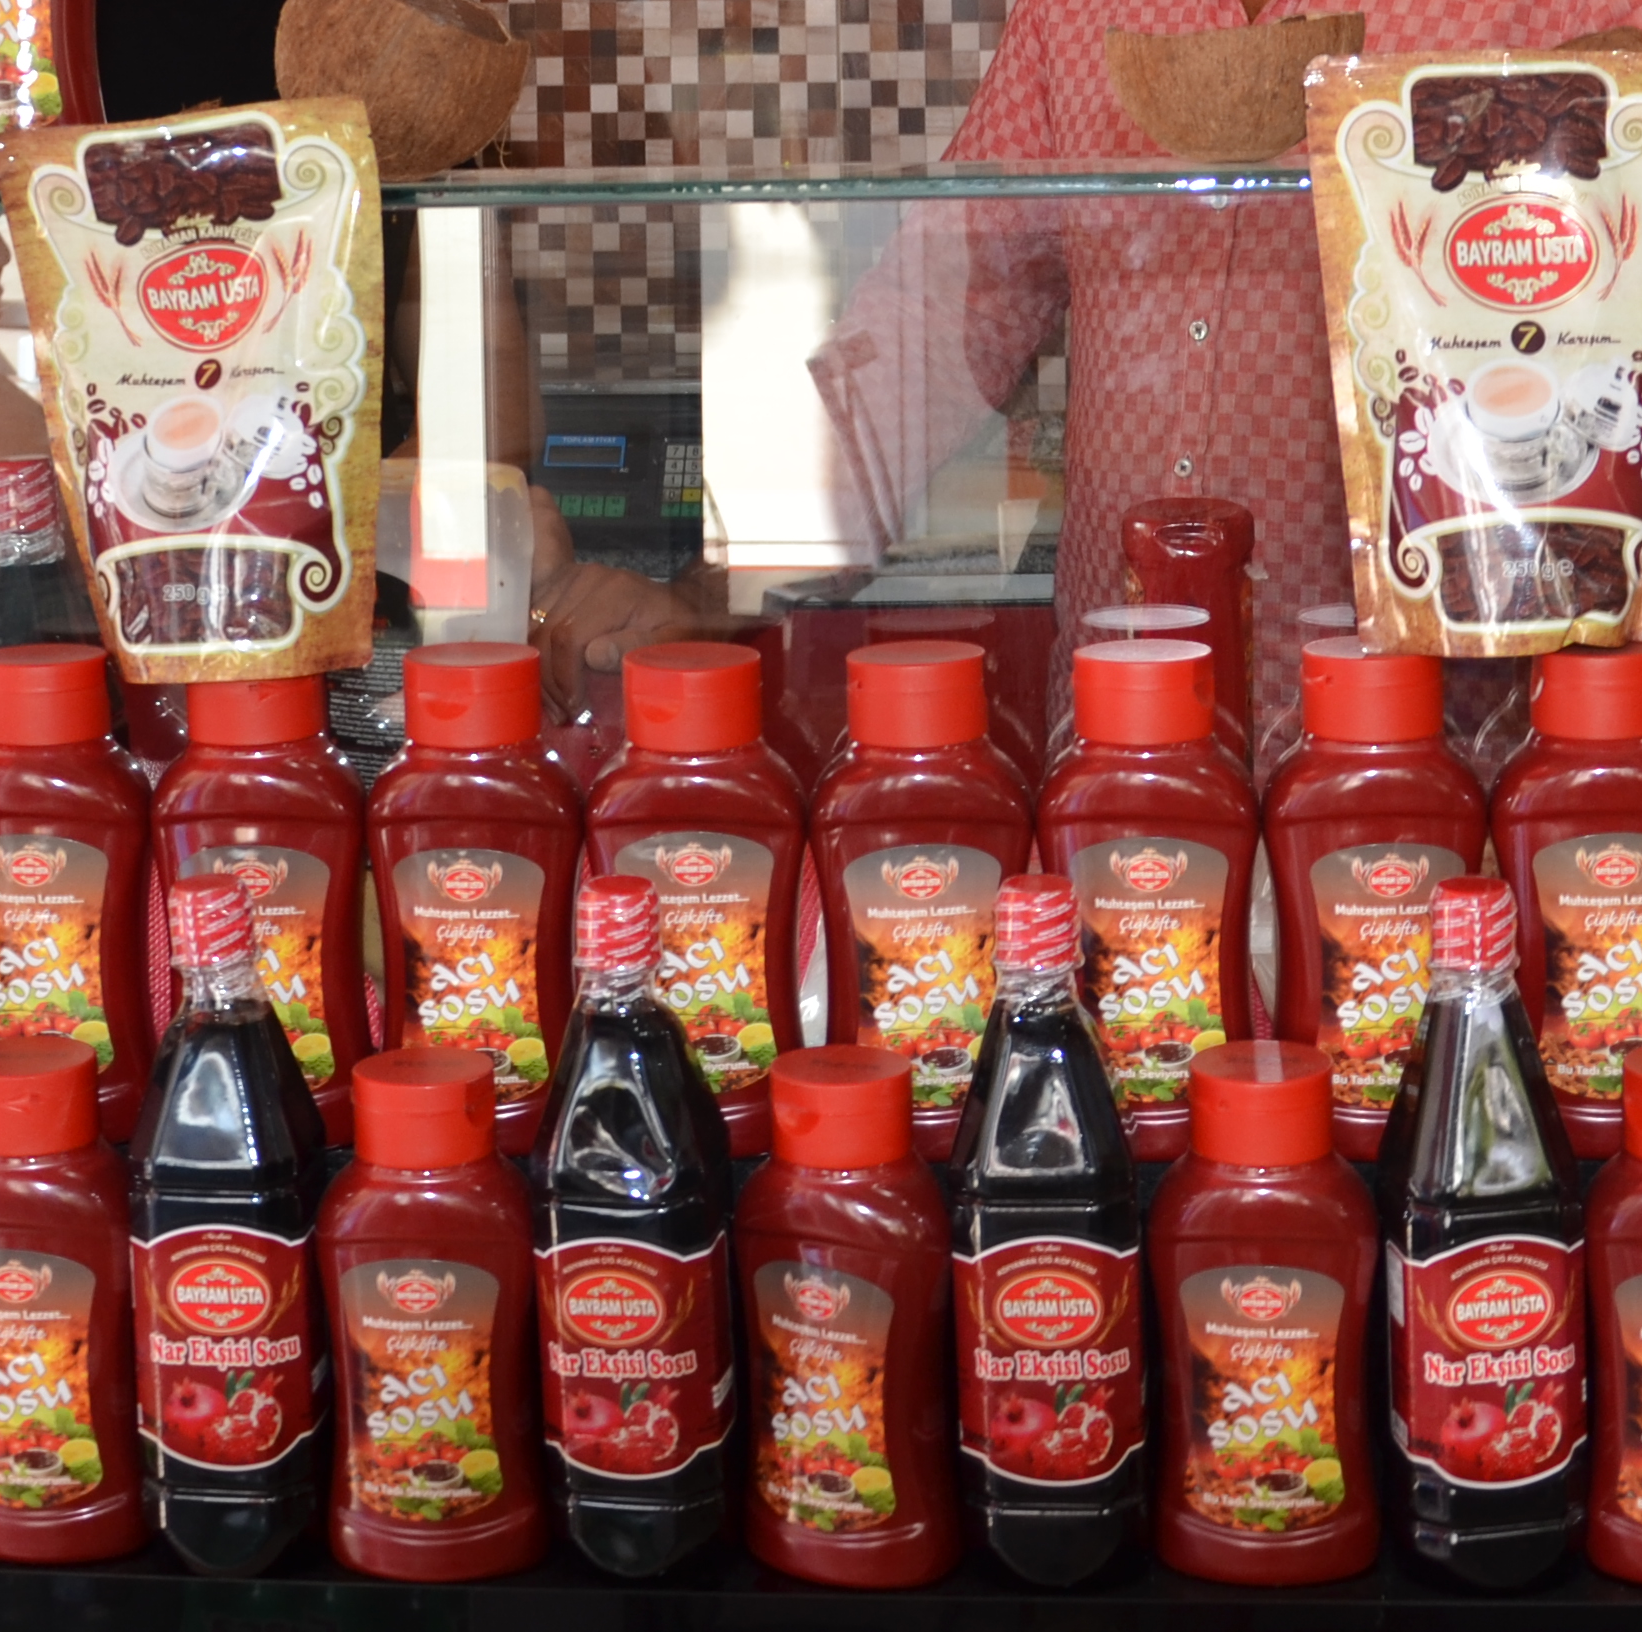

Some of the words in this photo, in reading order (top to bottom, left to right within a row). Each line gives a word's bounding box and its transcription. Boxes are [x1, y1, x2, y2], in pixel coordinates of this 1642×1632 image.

[1456, 239, 1533, 267] BAYRAM
[1535, 235, 1587, 264] USTA
[147, 282, 220, 311] BAYRAM
[220, 274, 260, 305] USTA
[1519, 326, 1537, 350] 7
[199, 363, 217, 386] 7
[163, 584, 195, 602] 250
[1094, 897, 1154, 912] Muhteşem
[176, 1285, 227, 1307] BAYRAM
[230, 1285, 264, 1306] USTA
[568, 1296, 621, 1318] BAYRAM
[624, 1298, 657, 1318] USTA
[1002, 1298, 1056, 1319] BAYRAM
[1059, 1298, 1096, 1317] USTA
[1457, 1299, 1508, 1321] BAYRAM
[1511, 1296, 1545, 1317] USTA
[151, 1333, 187, 1364] Nar
[189, 1336, 251, 1369] Ekşisi
[254, 1333, 300, 1364] Sosu
[548, 1347, 581, 1377] Nar
[582, 1349, 646, 1381] Ekşisi
[647, 1349, 697, 1379] Sosu
[976, 1348, 1013, 1379] Nar
[1016, 1348, 1082, 1382] Ekşisi
[1083, 1348, 1131, 1377] Sosu
[1424, 1350, 1463, 1384] Nar
[1466, 1350, 1532, 1386] Ekşisi
